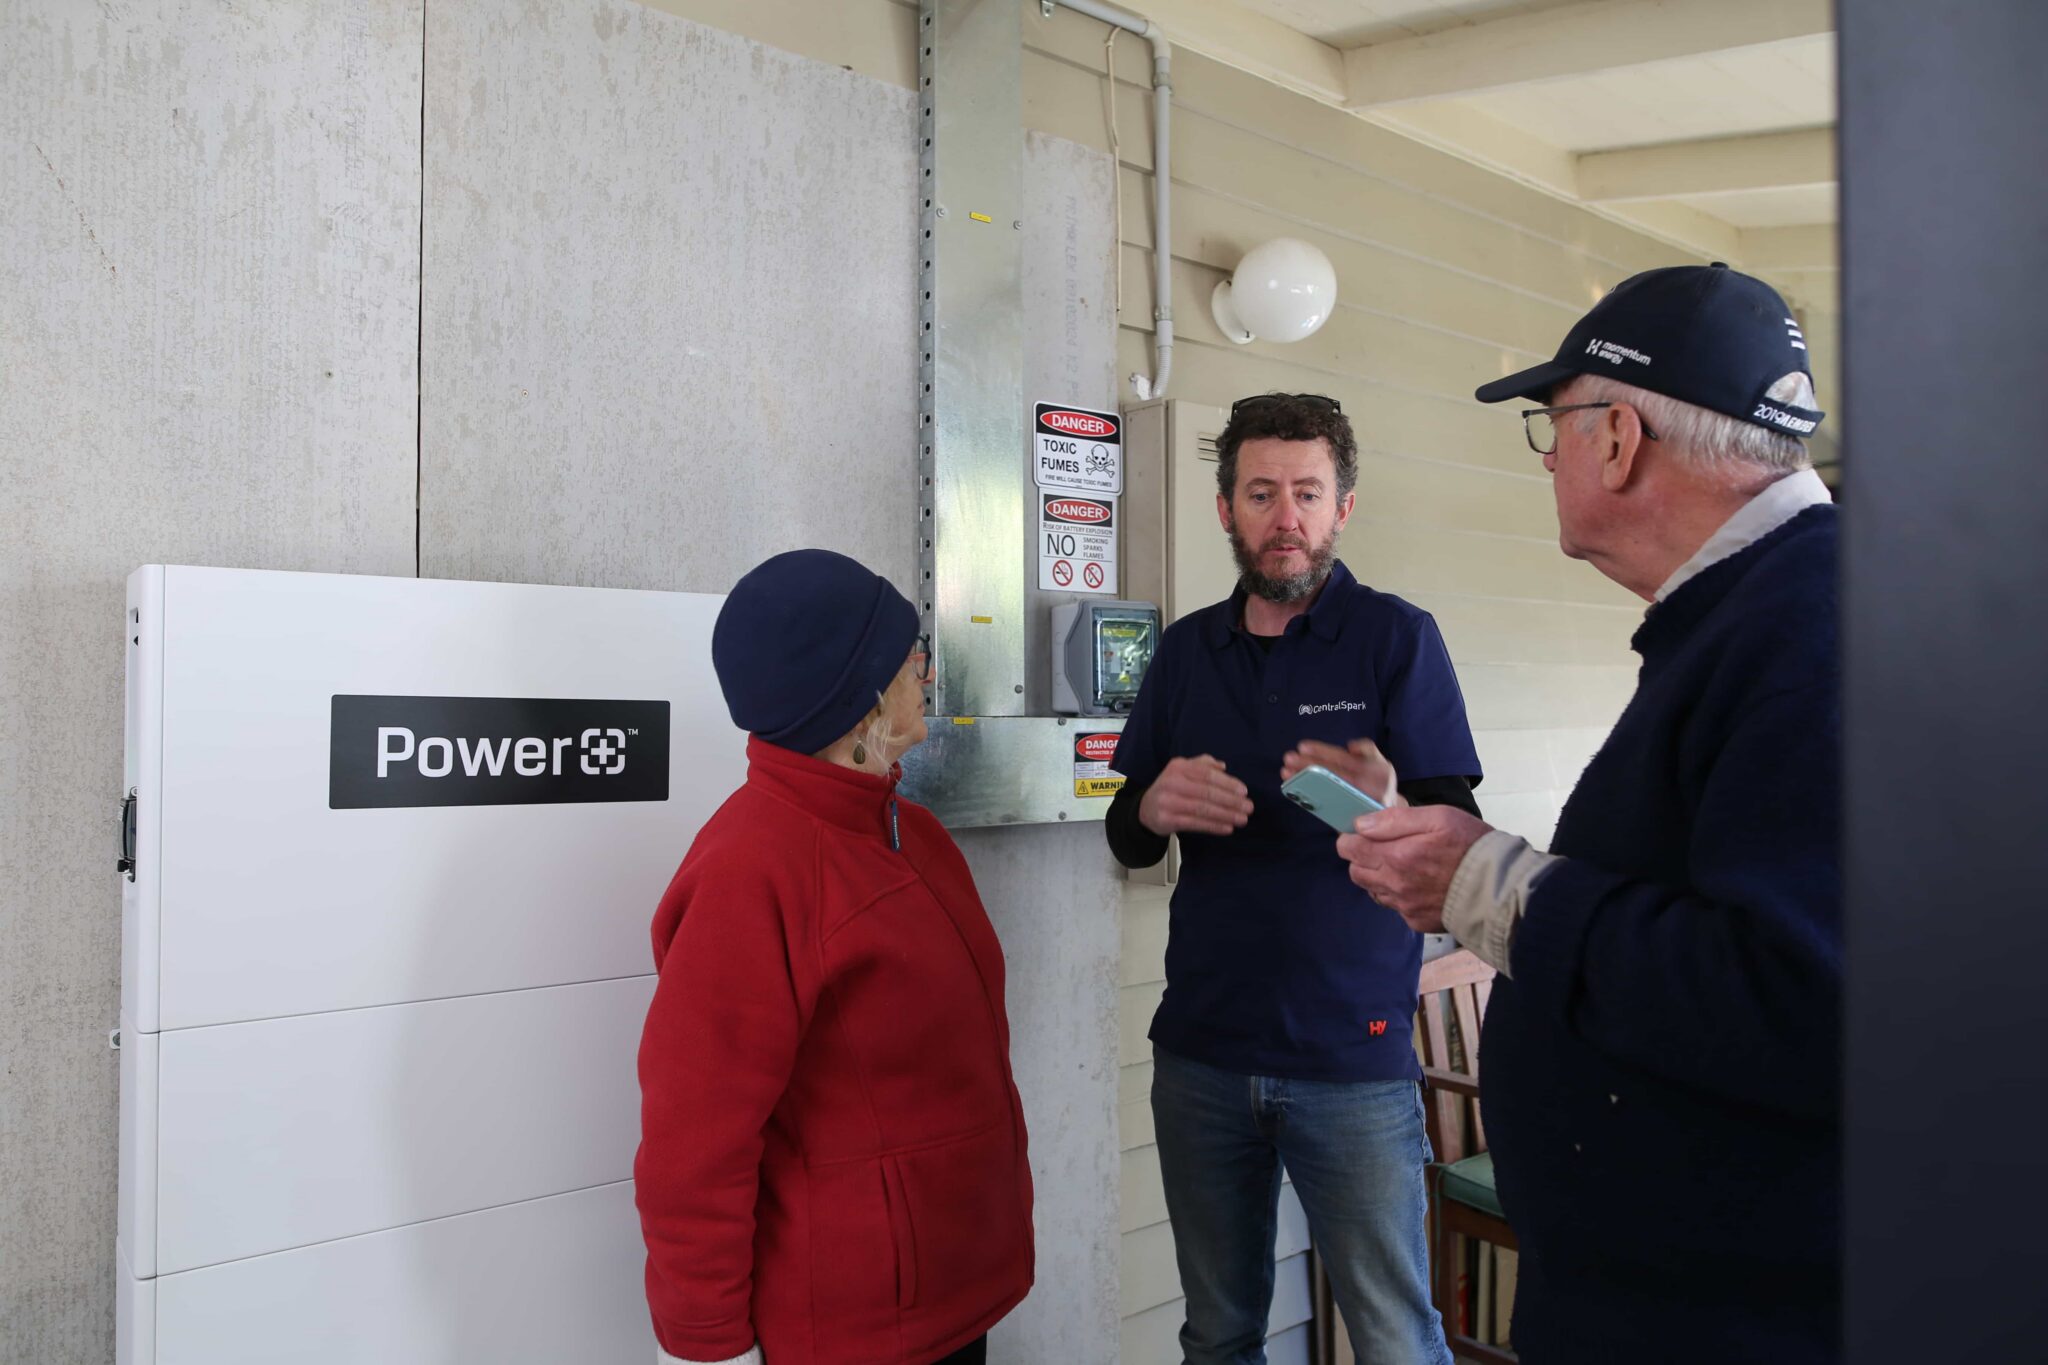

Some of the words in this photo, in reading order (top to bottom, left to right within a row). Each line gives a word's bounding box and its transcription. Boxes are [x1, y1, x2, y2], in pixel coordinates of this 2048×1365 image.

[1598, 349, 1623, 365] energy
[1602, 342, 1651, 366] momentum
[1052, 414, 1105, 434] DANGER
[1043, 439, 1077, 455] TOXIC
[1041, 457, 1079, 473] FUMES
[1097, 480, 1112, 488] FUMES
[1052, 503, 1104, 519] DANGER
[1063, 524, 1085, 533] BATTERY
[1085, 526, 1113, 536] EXPLOSION
[1047, 533, 1076, 556] NO
[1083, 537, 1109, 545] SMOKING
[1313, 700, 1366, 713] CentralSpark
[376, 726, 573, 778] Power
